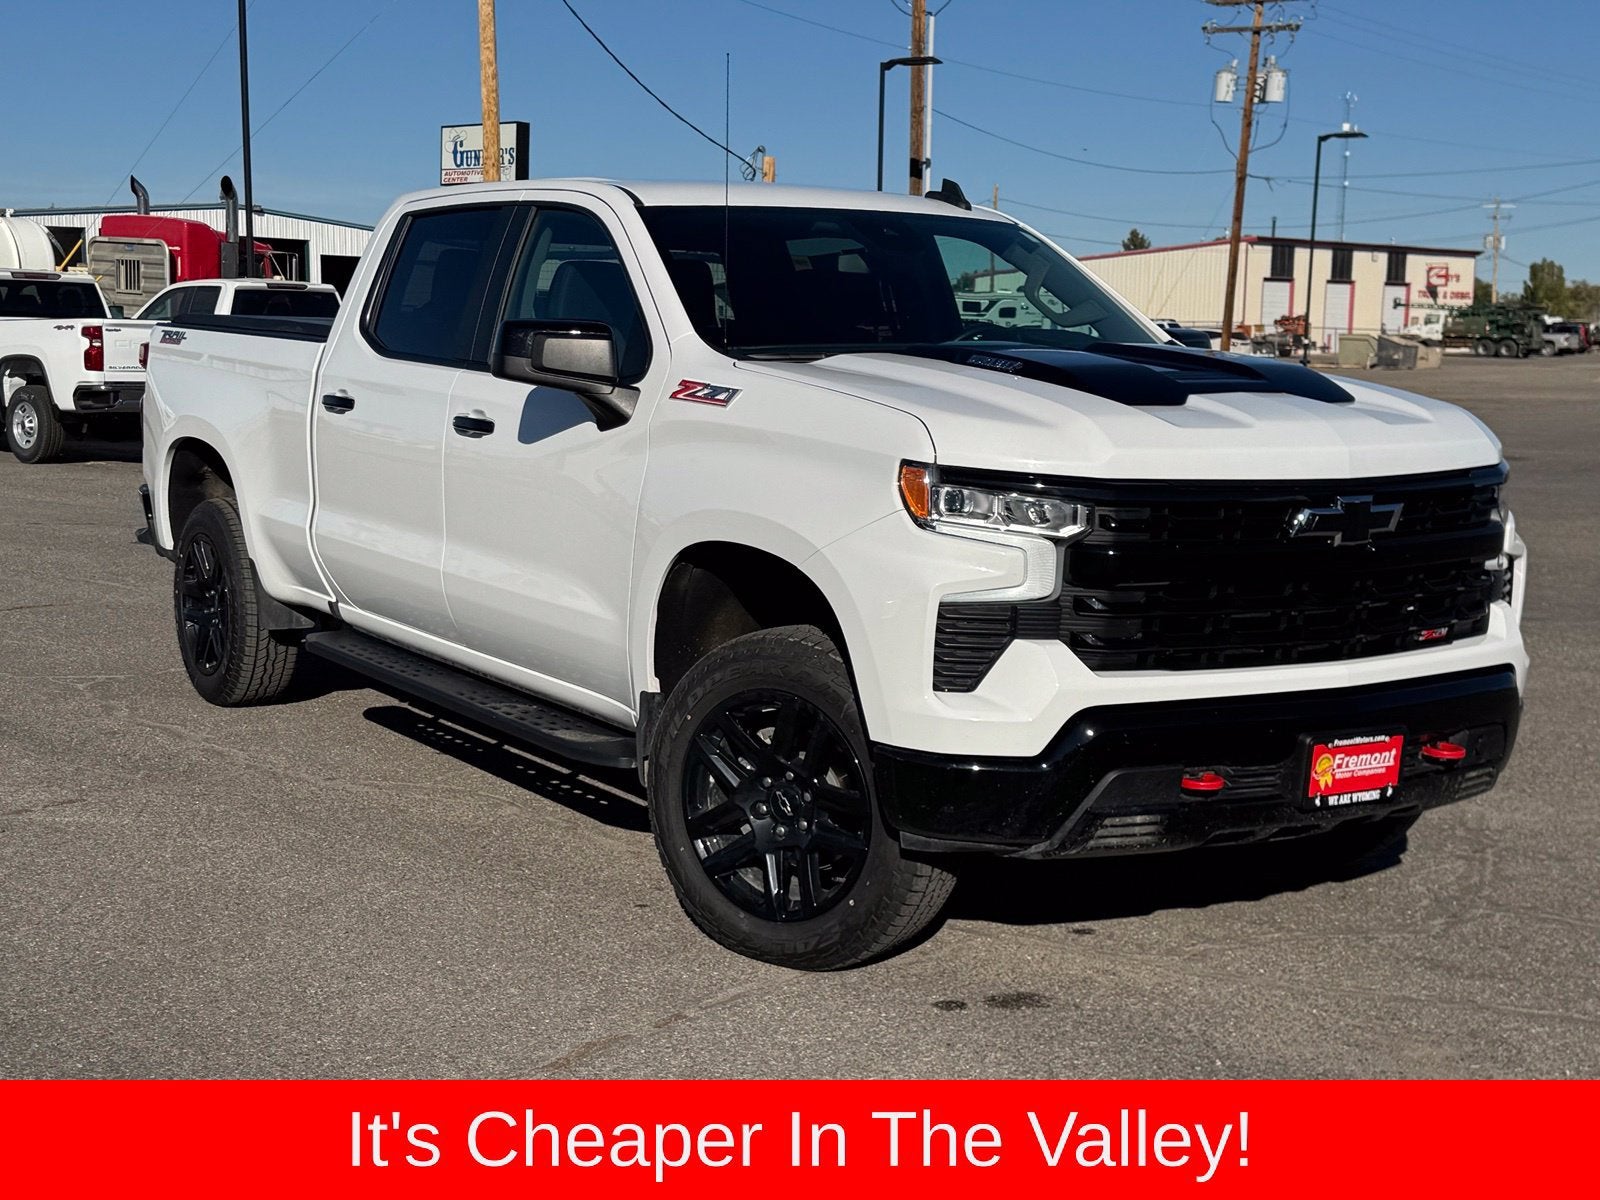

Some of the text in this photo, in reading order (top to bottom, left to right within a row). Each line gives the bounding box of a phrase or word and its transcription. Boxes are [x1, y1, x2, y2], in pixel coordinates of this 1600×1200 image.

[453, 140, 515, 167] GUNR'S
[161, 330, 187, 339] TRAIL
[669, 379, 742, 407] Z71
[1333, 748, 1397, 769] Fremont
[1335, 770, 1353, 779] Motor
[1328, 790, 1381, 806] WE ARE WYOMING
